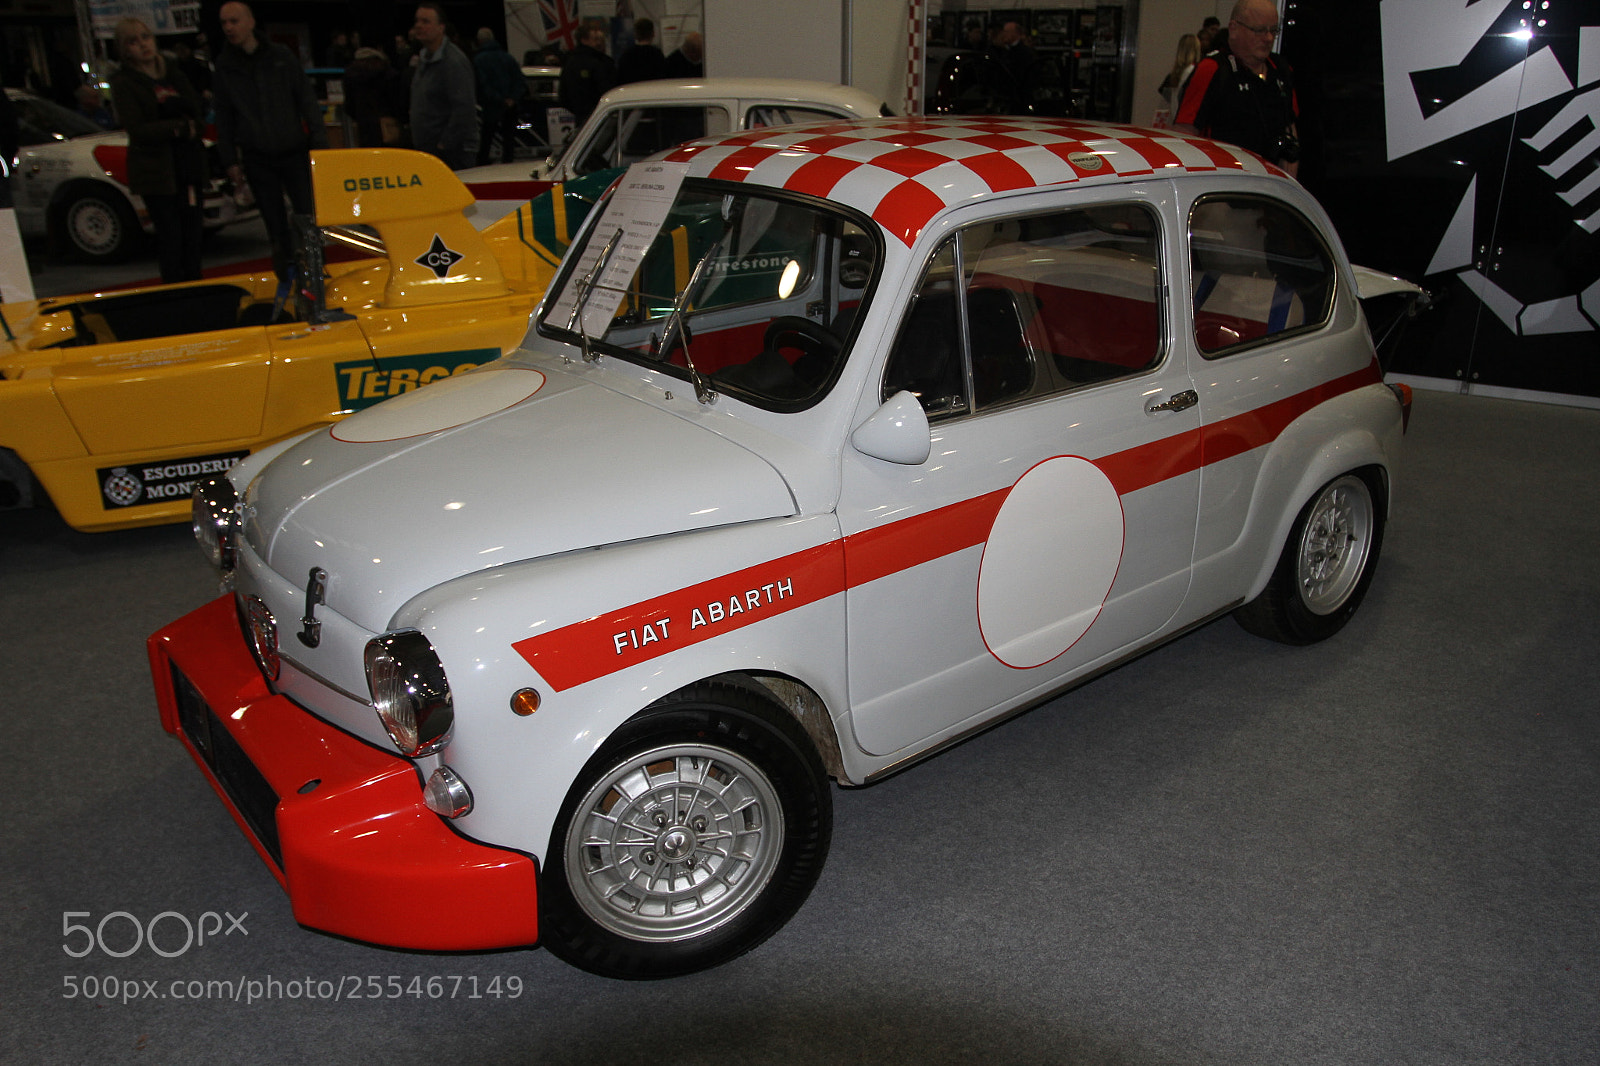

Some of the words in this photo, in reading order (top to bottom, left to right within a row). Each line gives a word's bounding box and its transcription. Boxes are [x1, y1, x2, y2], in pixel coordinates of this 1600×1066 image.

[343, 173, 423, 192] OSELLA
[427, 251, 452, 267] CS
[706, 256, 790, 276] Firestone
[145, 480, 196, 499] MON
[612, 617, 671, 655] FIAT
[690, 577, 794, 630] ABARTH
